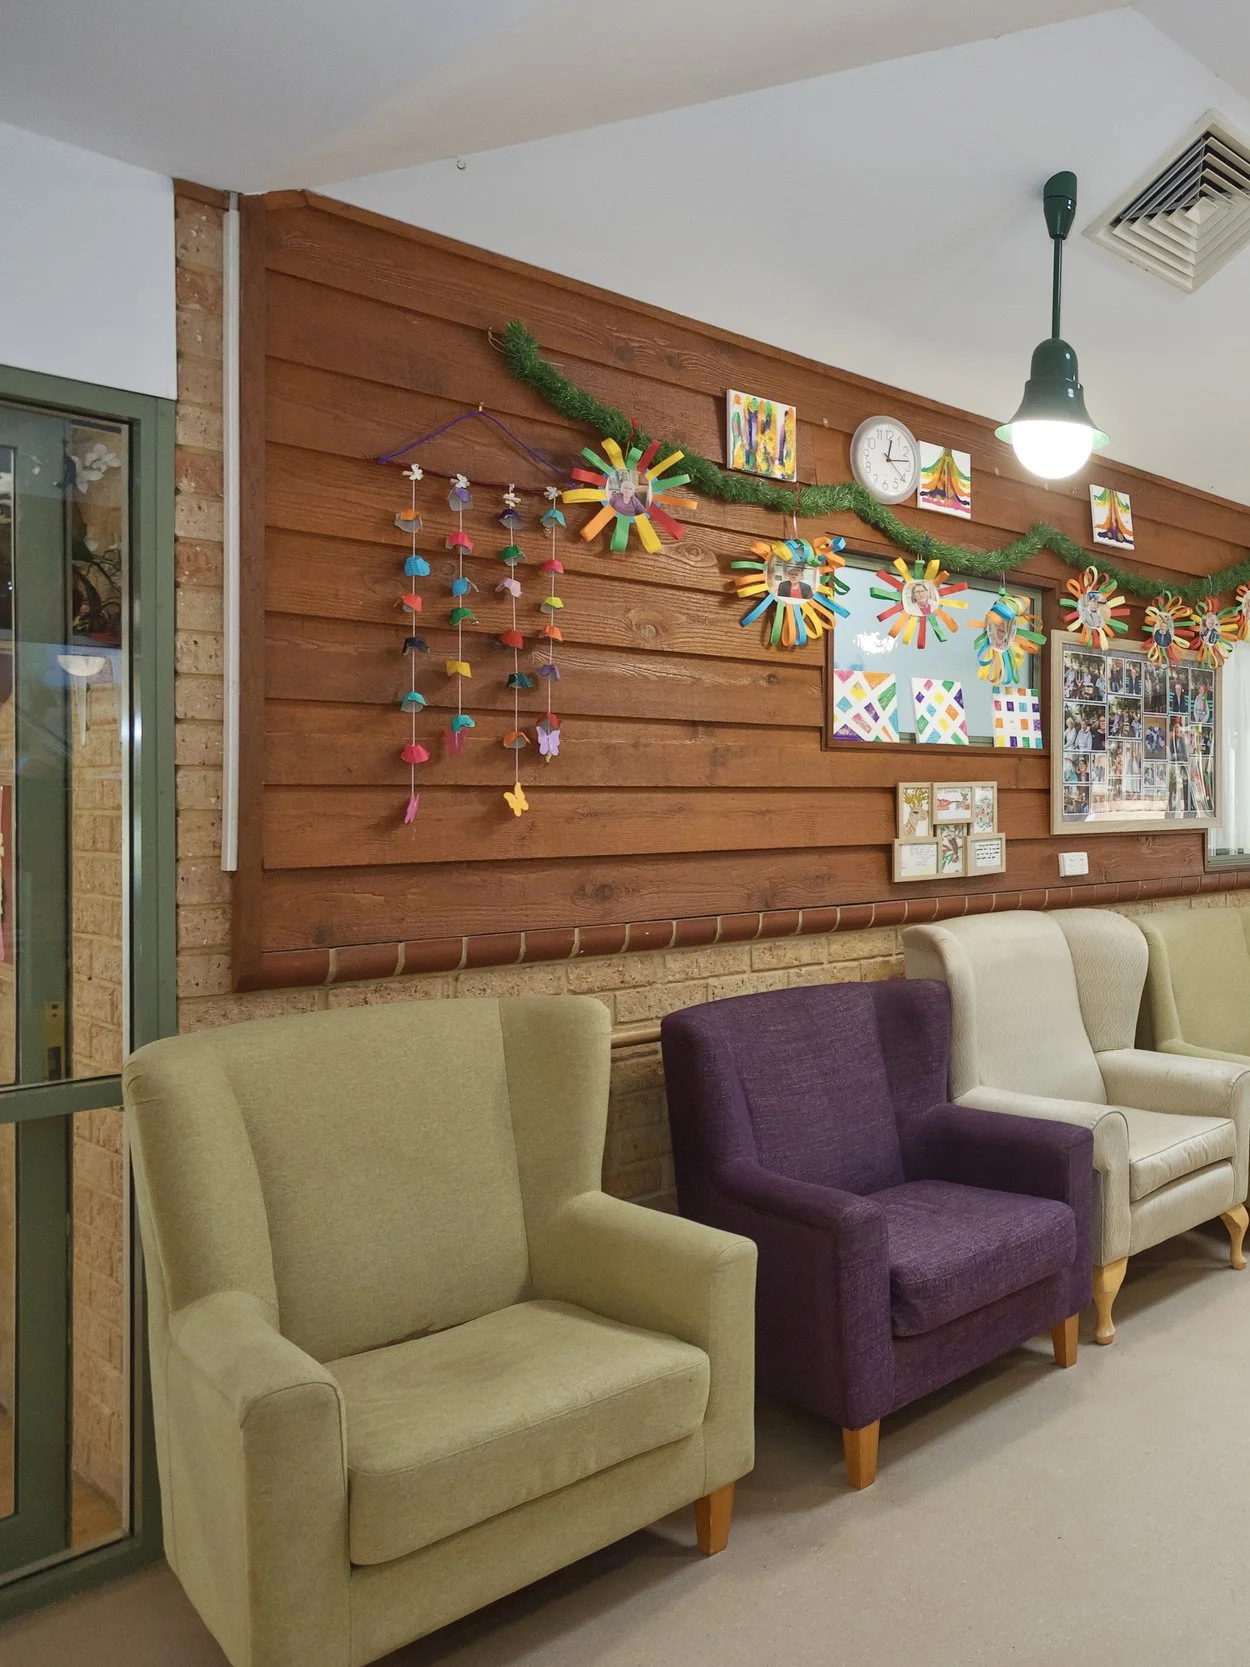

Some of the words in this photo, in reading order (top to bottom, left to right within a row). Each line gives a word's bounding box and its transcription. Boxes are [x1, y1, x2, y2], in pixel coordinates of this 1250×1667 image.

[876, 429, 883, 440] 11
[885, 429, 894, 440] 12
[867, 437, 876, 449] 10
[863, 448, 869, 460] 9
[902, 445, 909, 457] 2
[865, 461, 871, 473] 8
[873, 473, 879, 484] 7
[892, 477, 899, 490] 5
[899, 473, 906, 483] 4
[882, 480, 889, 490] 6
